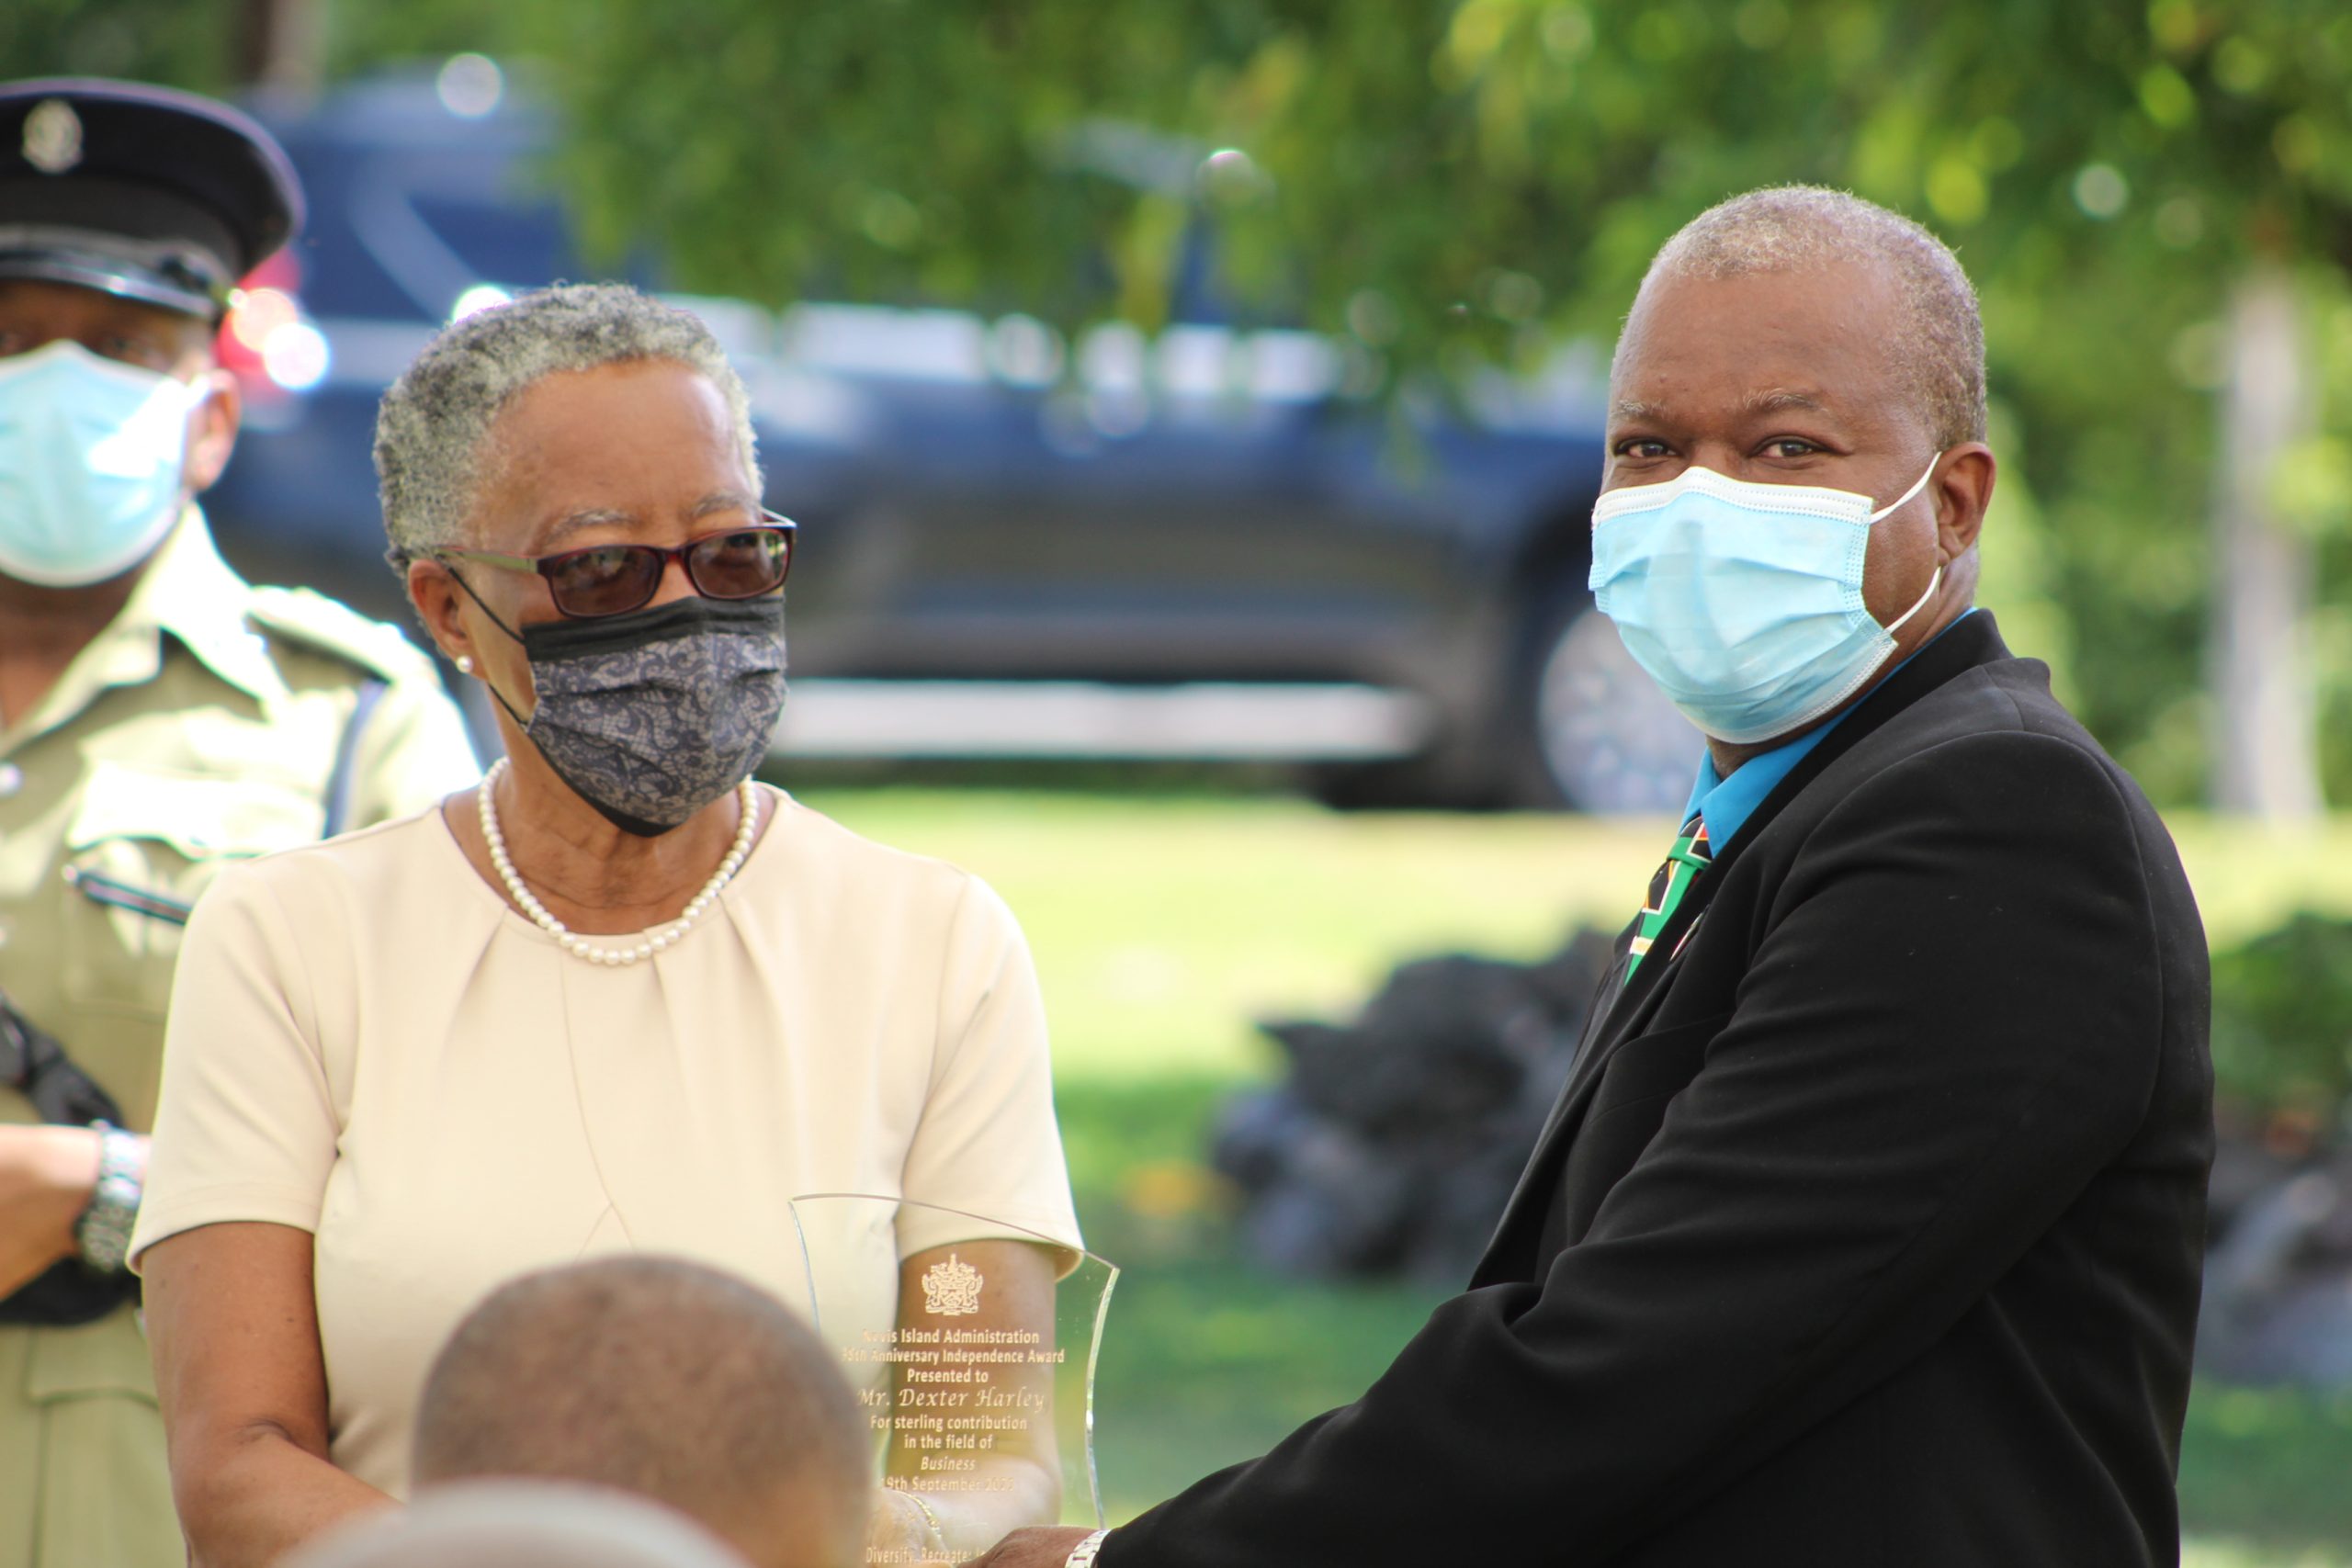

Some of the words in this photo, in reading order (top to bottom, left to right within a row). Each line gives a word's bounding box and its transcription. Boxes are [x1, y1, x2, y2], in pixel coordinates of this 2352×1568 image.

[901, 1327, 940, 1343] Island
[944, 1328, 1040, 1344] Administration
[871, 1347, 939, 1365] Anniversary
[943, 1349, 1024, 1366] Independence
[1027, 1348, 1066, 1363] Award
[907, 1368, 972, 1382] Presented
[975, 1369, 989, 1382] to
[856, 1388, 891, 1406] Mr.
[899, 1388, 969, 1406] Dexter
[975, 1386, 1046, 1414] Harley
[870, 1416, 891, 1429] For
[894, 1414, 944, 1433] sterling
[947, 1415, 1028, 1430] contribution
[904, 1434, 917, 1449] in
[921, 1434, 942, 1449] the
[945, 1433, 976, 1449] field
[979, 1433, 993, 1449] of
[920, 1455, 977, 1471] Business
[911, 1475, 981, 1494] September
